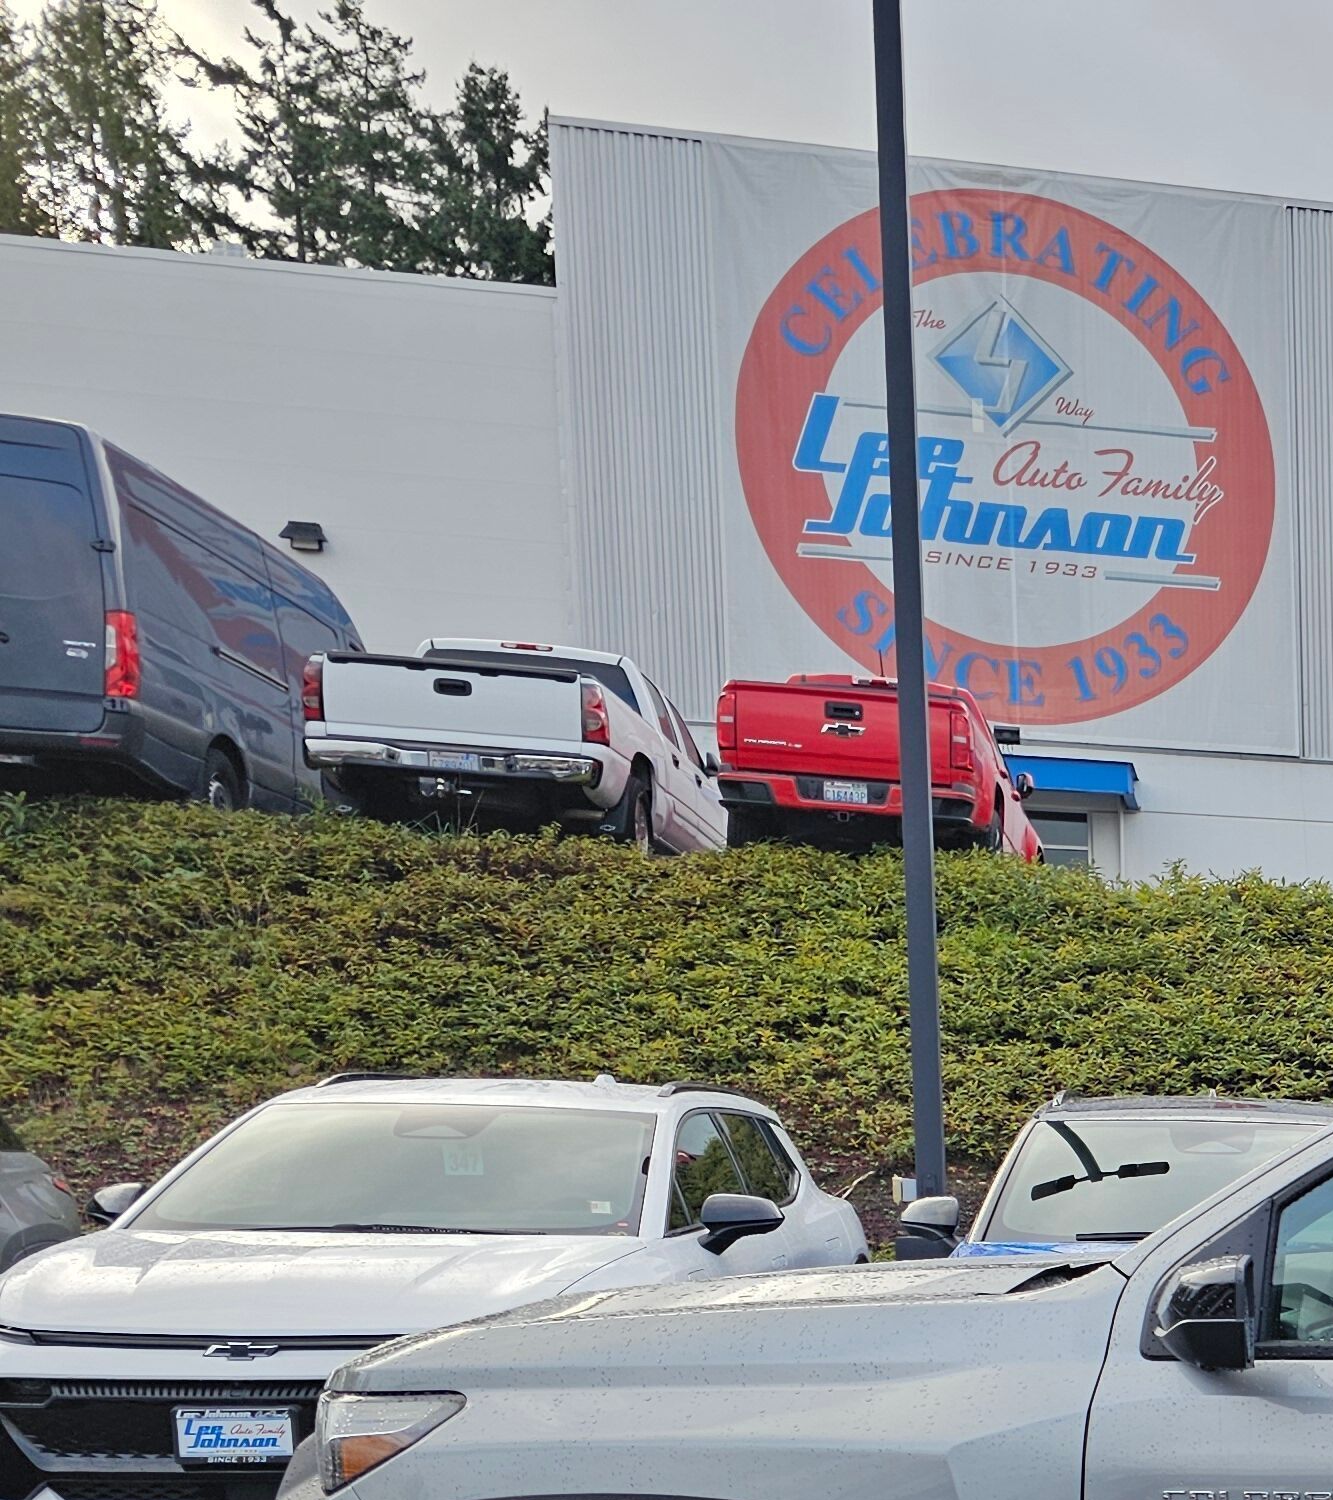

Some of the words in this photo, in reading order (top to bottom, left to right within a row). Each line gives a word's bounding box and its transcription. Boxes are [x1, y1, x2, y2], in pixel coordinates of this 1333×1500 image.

[913, 309, 946, 330] The
[1055, 396, 1095, 426] Way
[992, 440, 1087, 491] Auto
[1094, 448, 1223, 524] Family
[803, 475, 1196, 563] Johnson
[925, 550, 1013, 571] SINCE
[1029, 560, 1098, 579] 1933
[1067, 612, 1189, 702] 1933
[184, 1418, 225, 1436] Lee
[230, 1424, 253, 1436] Auto
[255, 1424, 286, 1438] Family
[187, 1434, 281, 1449] Johnson
[207, 1456, 237, 1464] SINCE
[242, 1456, 267, 1464] 1933
